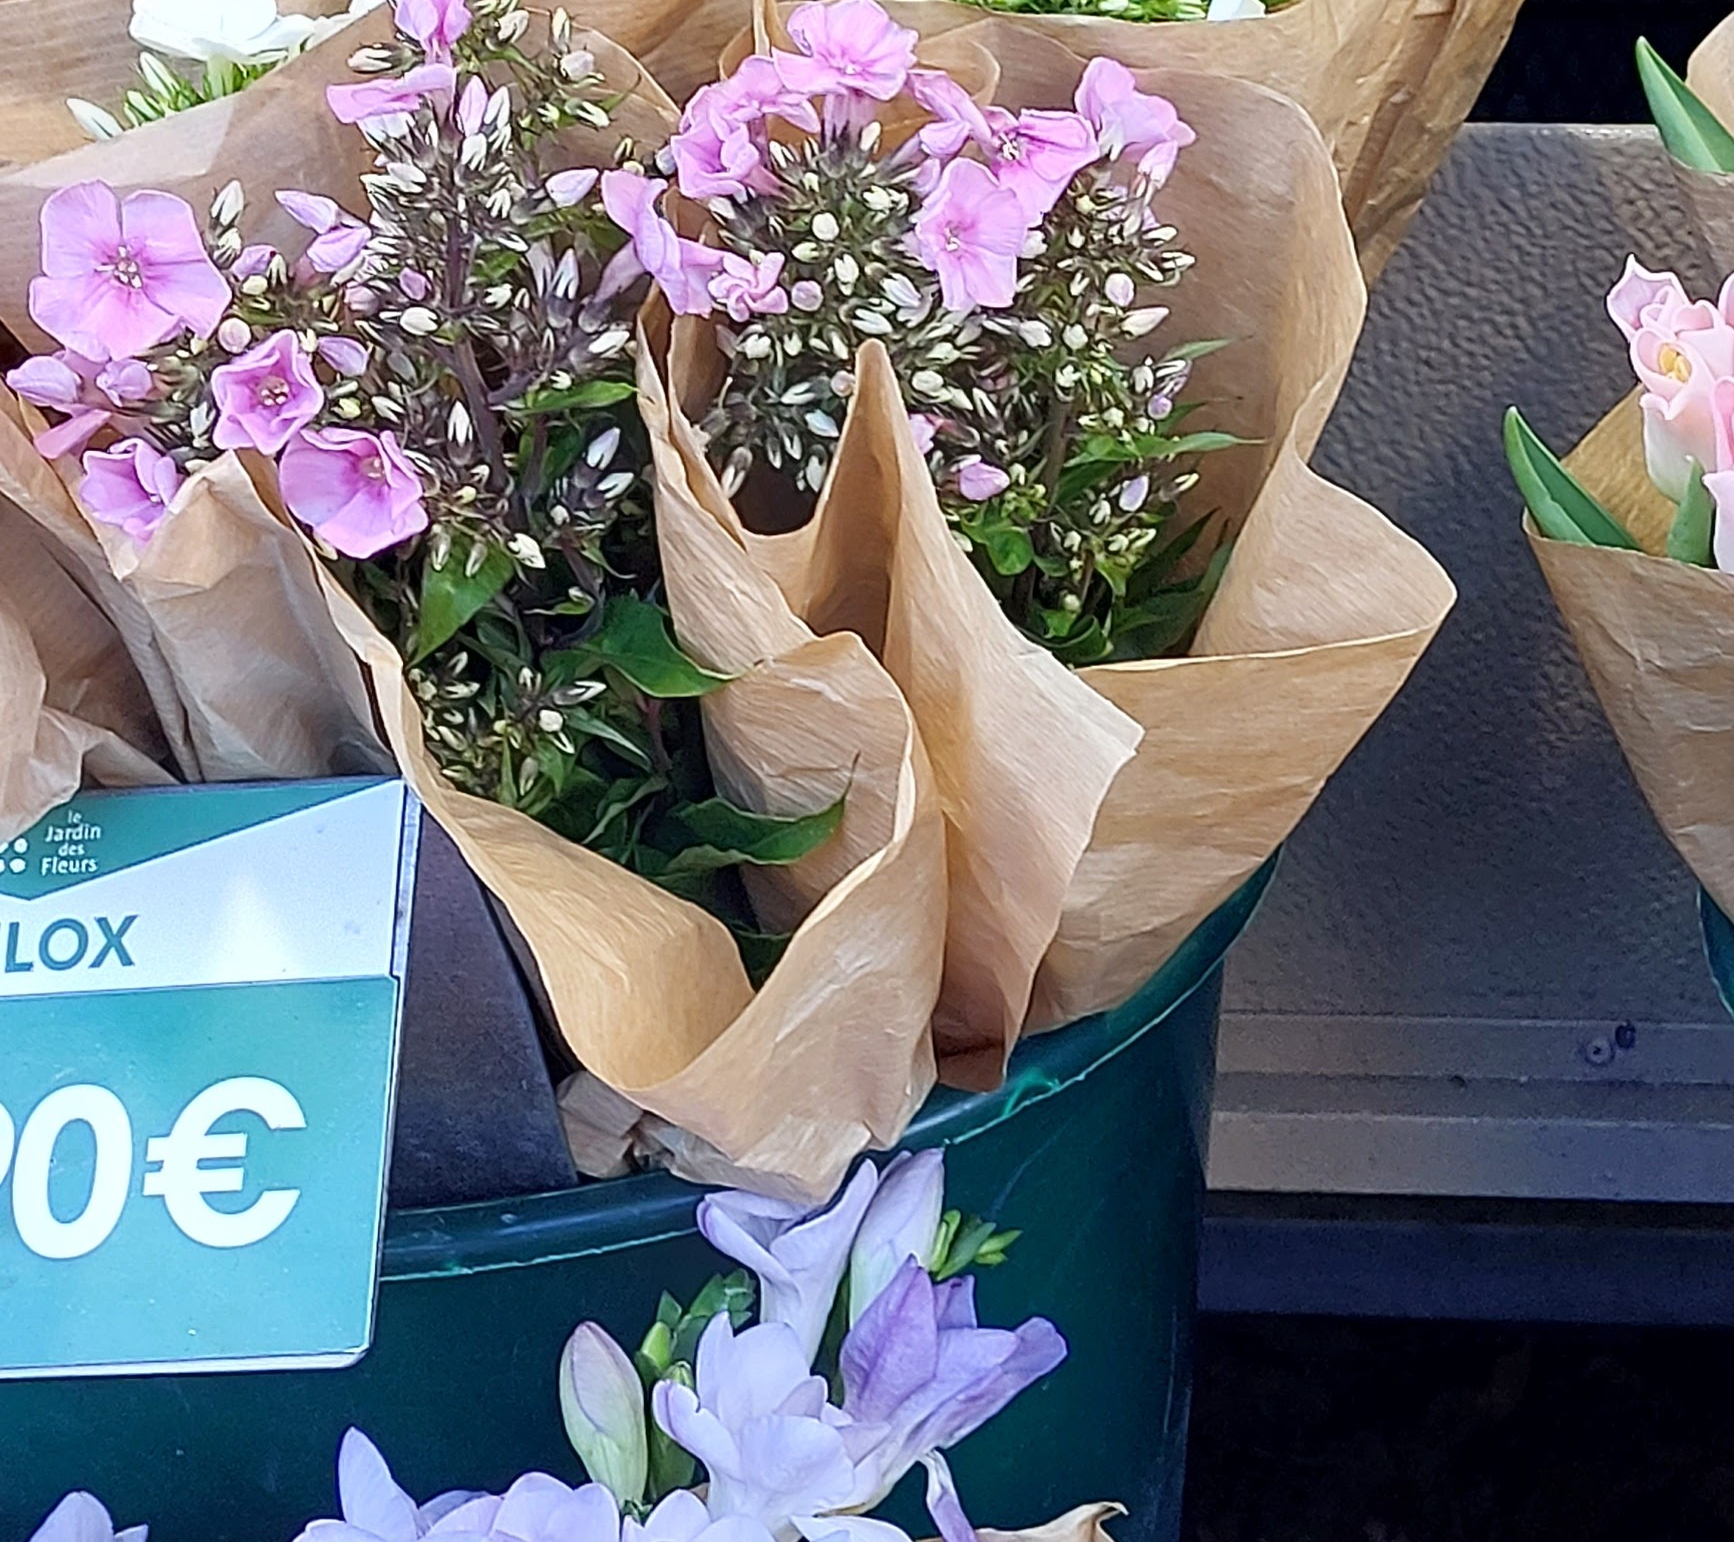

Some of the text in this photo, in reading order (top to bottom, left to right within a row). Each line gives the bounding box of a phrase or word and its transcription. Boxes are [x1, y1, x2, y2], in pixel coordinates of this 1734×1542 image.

[68, 809, 82, 824] le
[45, 823, 101, 842] Jardin
[58, 842, 85, 856] des
[41, 857, 98, 876] Fleurs
[0, 914, 140, 973] LOX
[0, 1075, 308, 1260] 0€
